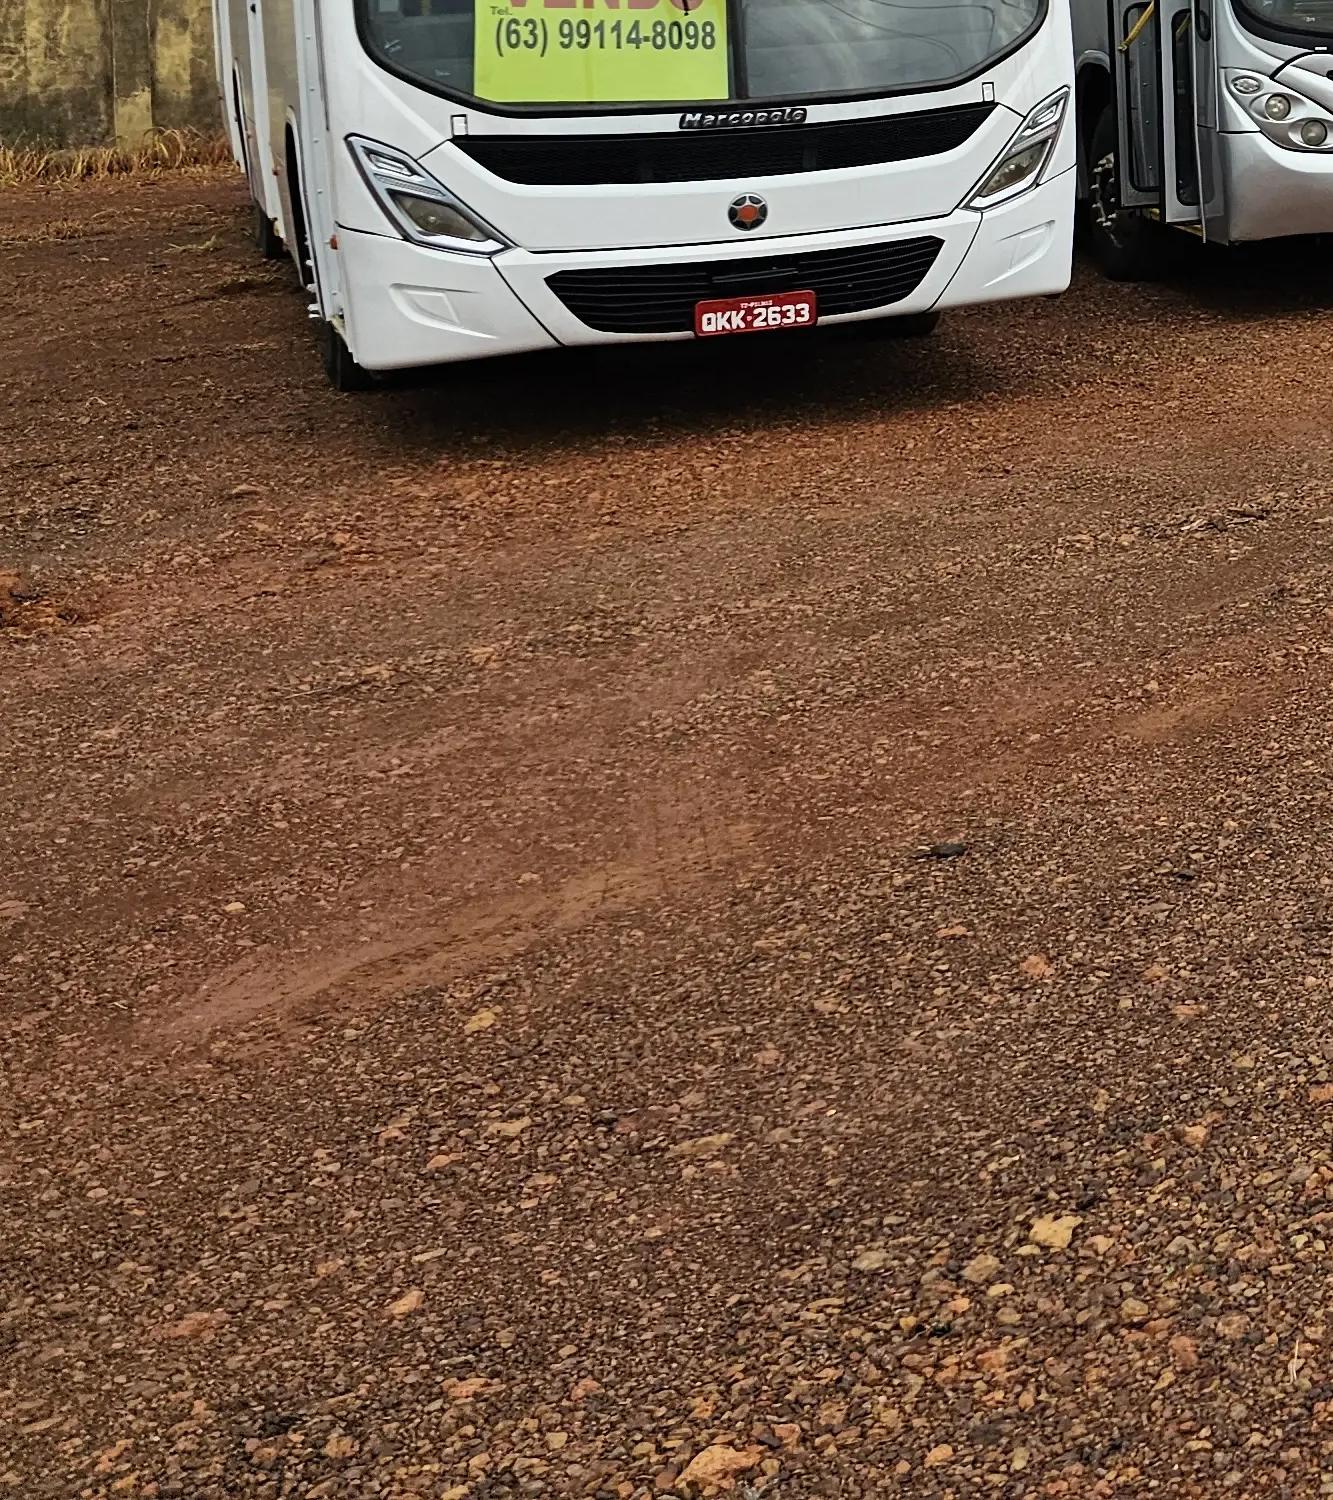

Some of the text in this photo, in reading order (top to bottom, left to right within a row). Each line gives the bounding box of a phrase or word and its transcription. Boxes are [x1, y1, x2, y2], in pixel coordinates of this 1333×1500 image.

[490, 5, 513, 16] Tel.
[496, 18, 716, 57] (63) 99114-8098
[682, 108, 805, 127] Marcopolo
